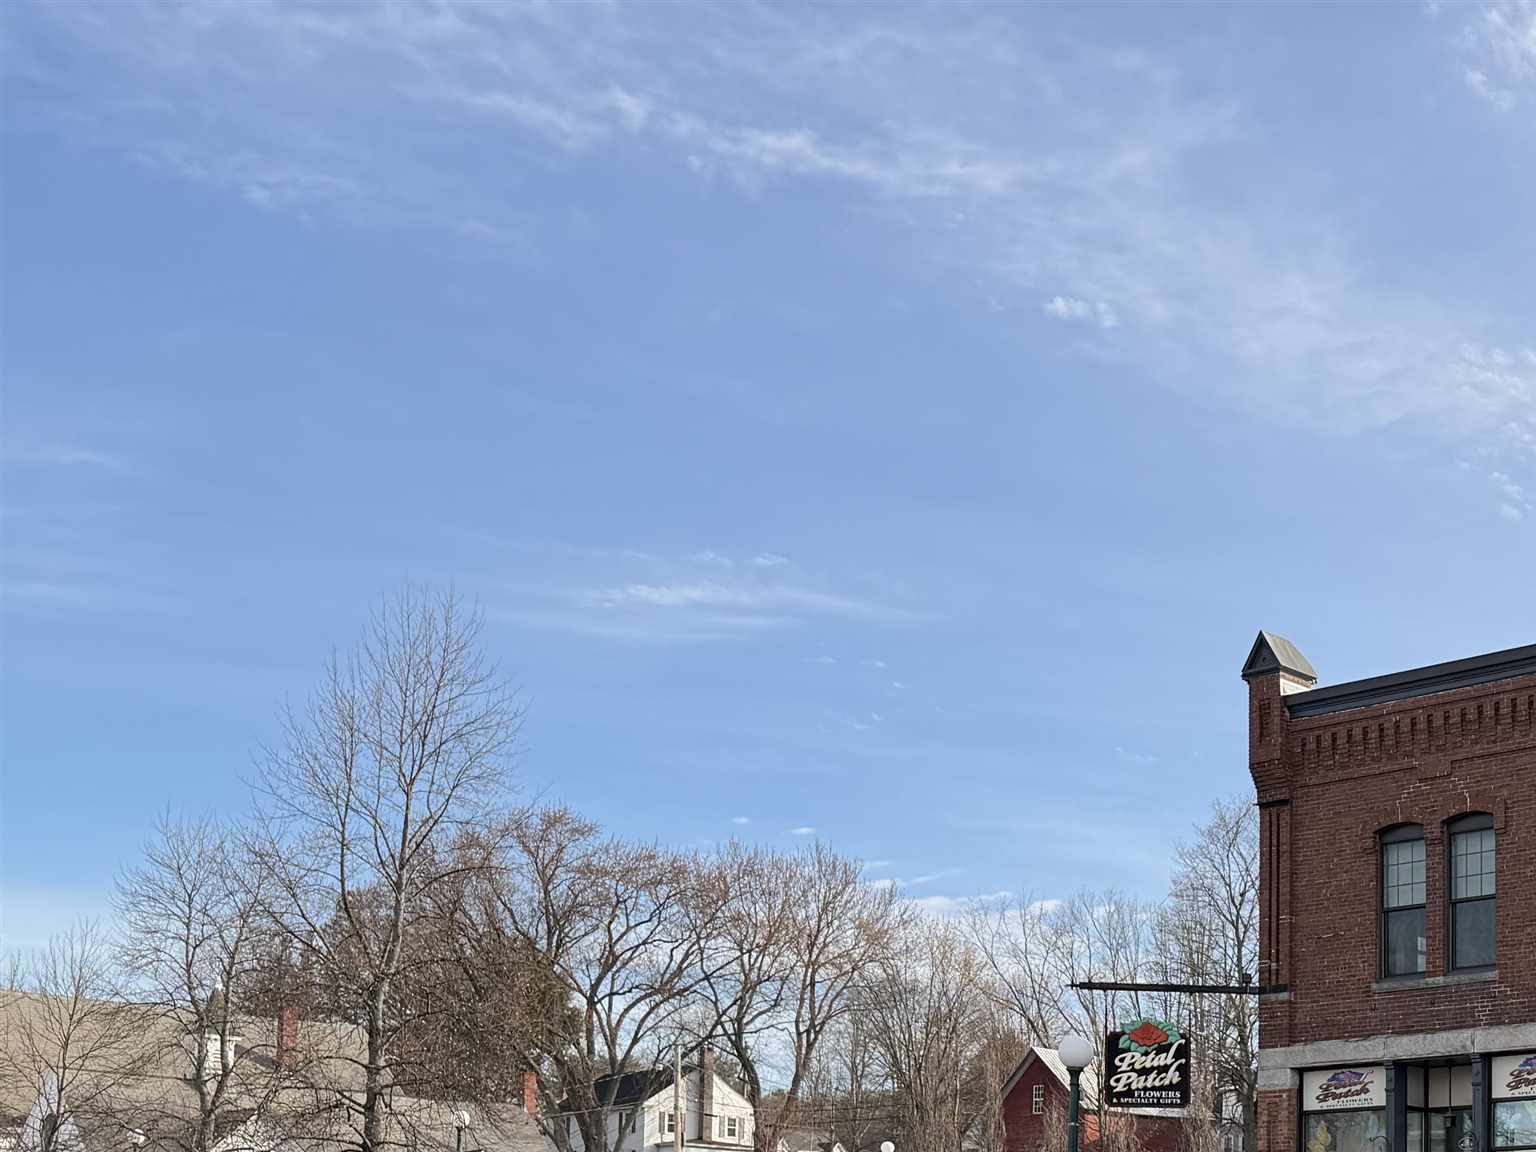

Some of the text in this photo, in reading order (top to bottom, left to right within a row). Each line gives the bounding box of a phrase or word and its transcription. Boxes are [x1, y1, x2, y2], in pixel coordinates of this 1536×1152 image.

[1114, 1039, 1186, 1072] Petal
[1109, 1059, 1186, 1092] Patch
[1134, 1090, 1181, 1098] FLOWERS
